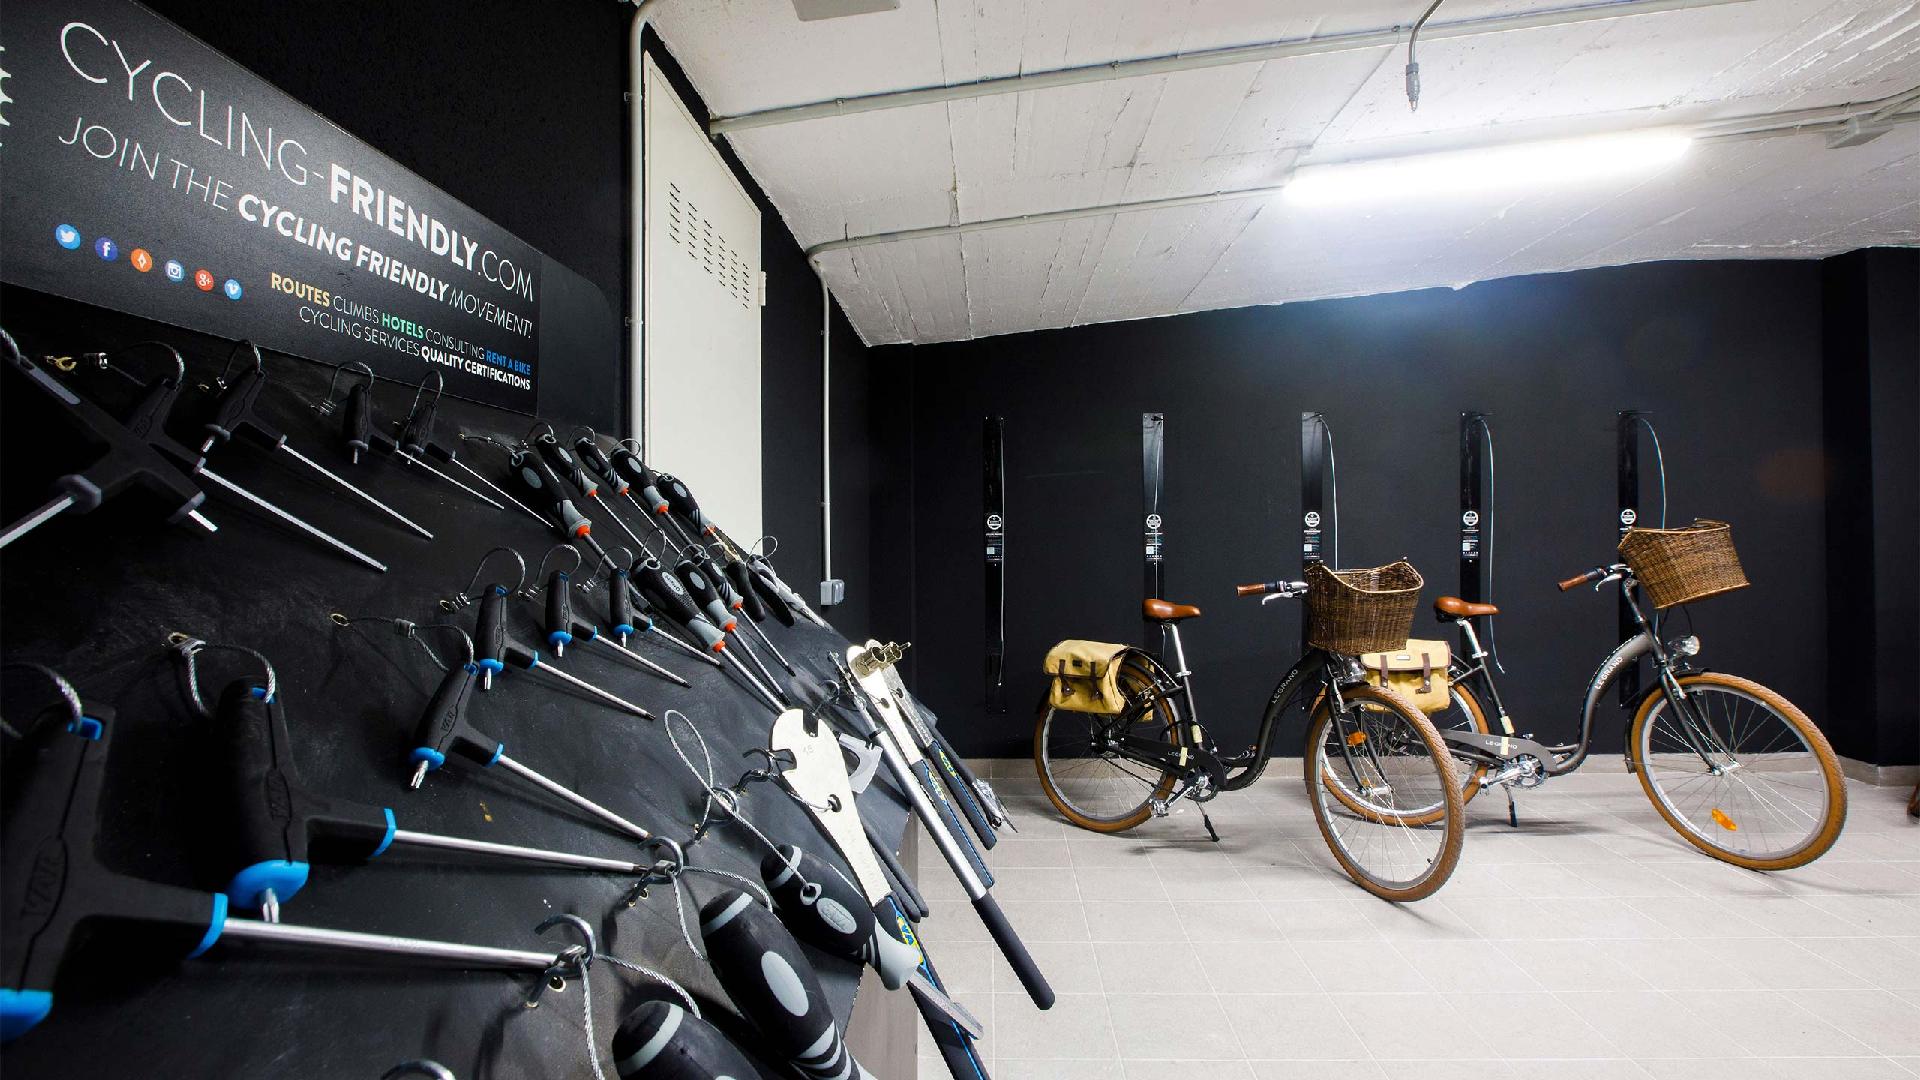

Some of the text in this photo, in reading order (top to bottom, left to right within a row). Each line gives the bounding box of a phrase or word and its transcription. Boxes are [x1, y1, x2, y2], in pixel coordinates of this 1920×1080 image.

[58, 117, 533, 339] JOIN THE CYCLING FRIENDLY MOVEMENT!
[60, 22, 533, 302] CYCLING-FRIENDLY.COM
[271, 272, 531, 376] ROUTES CLIMBS HOTELS CONSULTING RENT A BIKE
[299, 306, 531, 391] CYCLING SERVICES QUALITY CERTIFICATIONS
